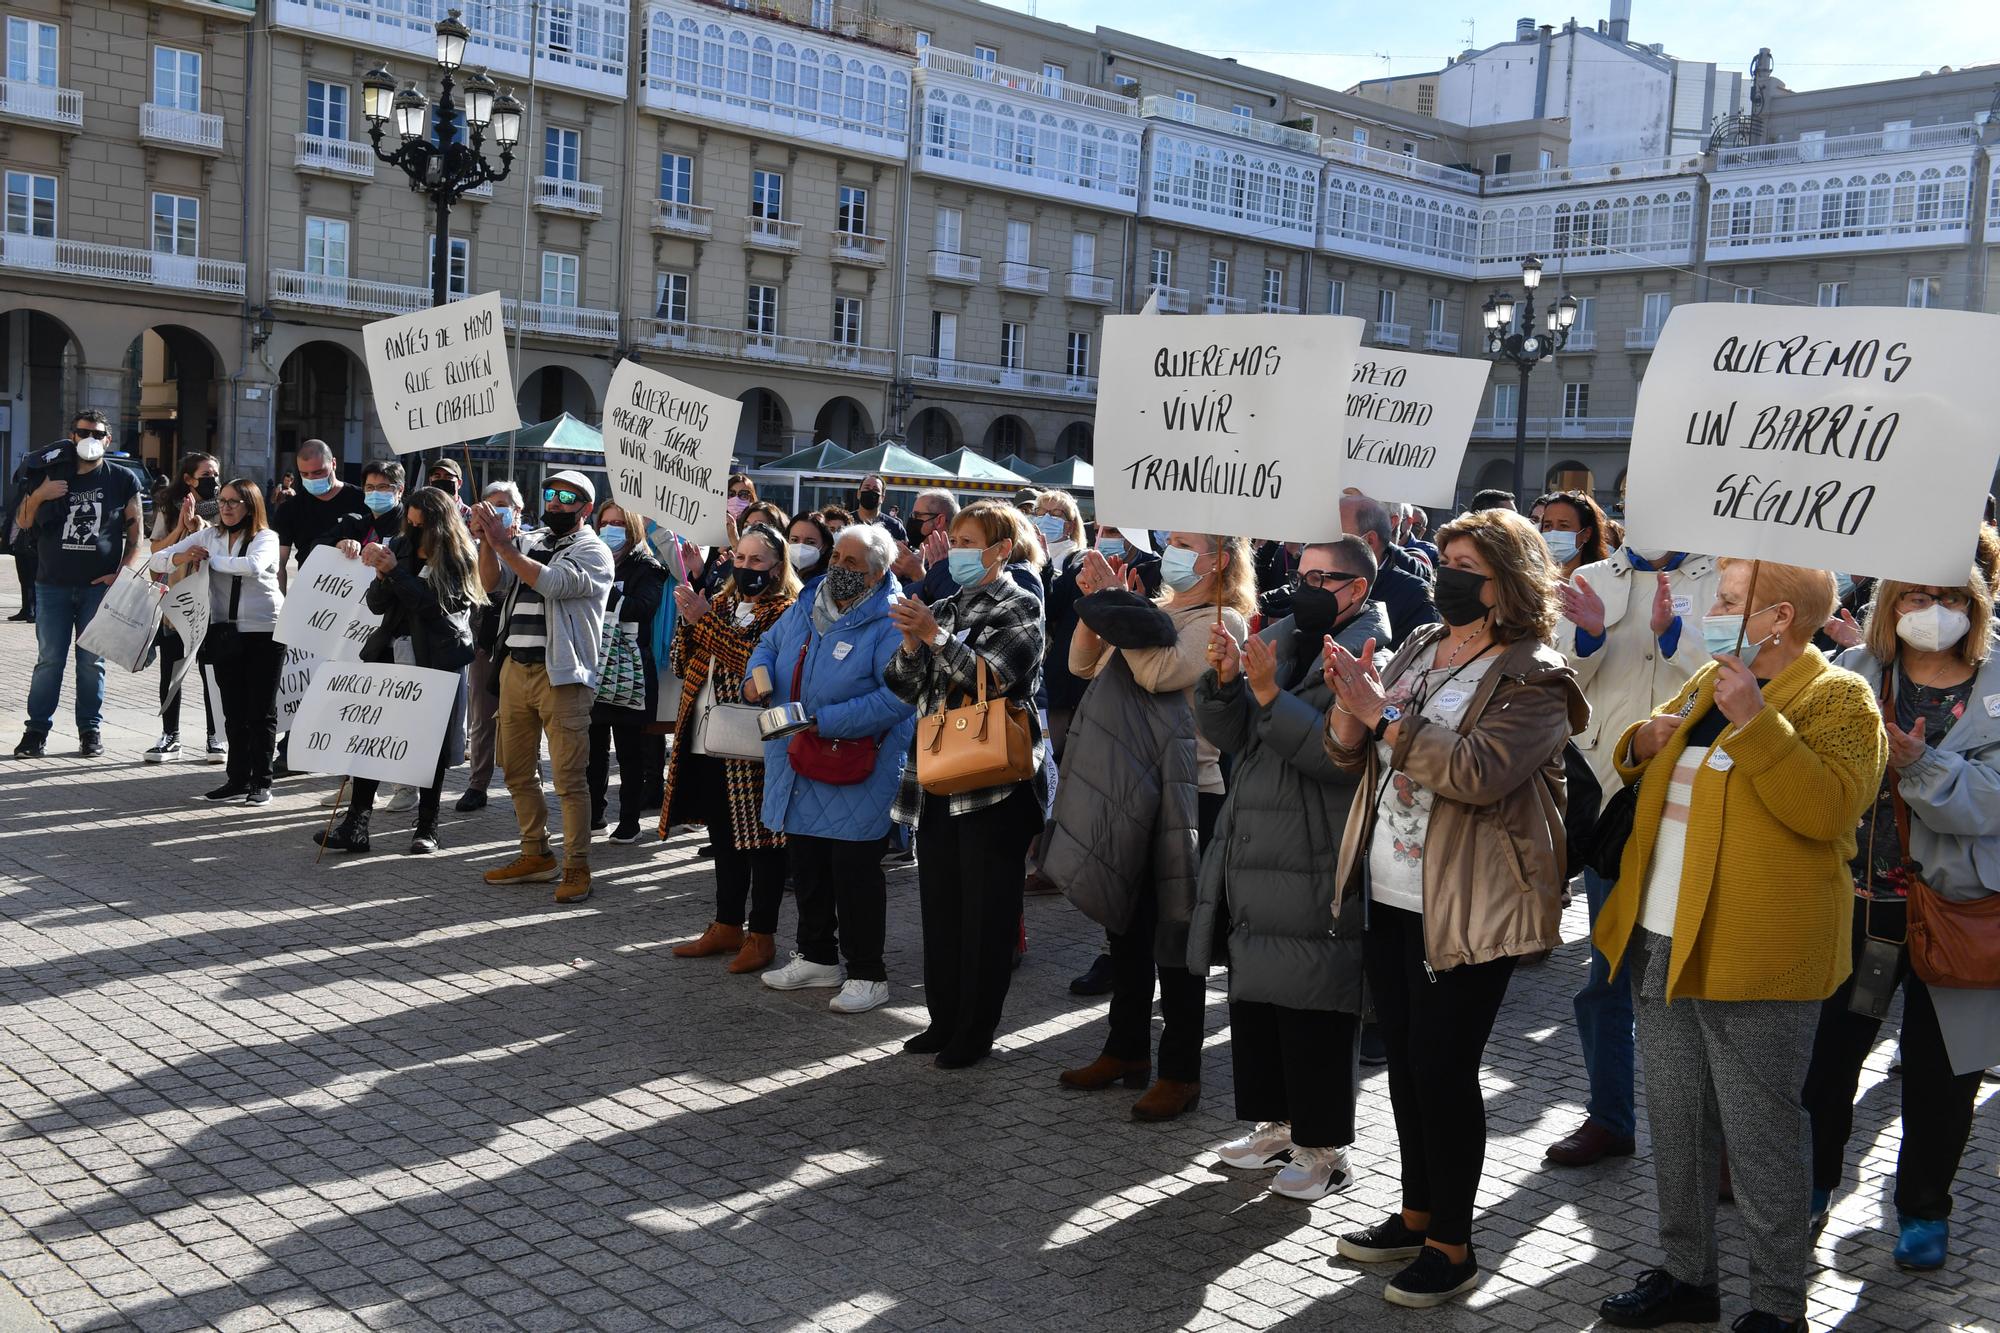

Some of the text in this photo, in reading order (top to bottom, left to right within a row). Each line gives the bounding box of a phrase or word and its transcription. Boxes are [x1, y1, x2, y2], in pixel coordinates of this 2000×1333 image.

[385, 310, 492, 360] ANTES DE MAYO
[405, 350, 491, 394] QUE QUITEN
[1154, 344, 1281, 377] QUEREMOS
[1713, 335, 1912, 383] QUEREMOS
[632, 380, 708, 432] QUEREMOS
[1163, 390, 1237, 434] VIVIR
[1347, 434, 1436, 468] VECINDAD
[1686, 401, 1899, 462] UN BARRIO
[620, 469, 642, 498] SIN
[1121, 450, 1282, 499] TRANQUILOS
[1713, 474, 1876, 535] SEGURO
[313, 574, 353, 598] MAIS
[307, 609, 337, 631] NO
[339, 704, 382, 725] FORA
[308, 732, 408, 760] DO BARRIO
